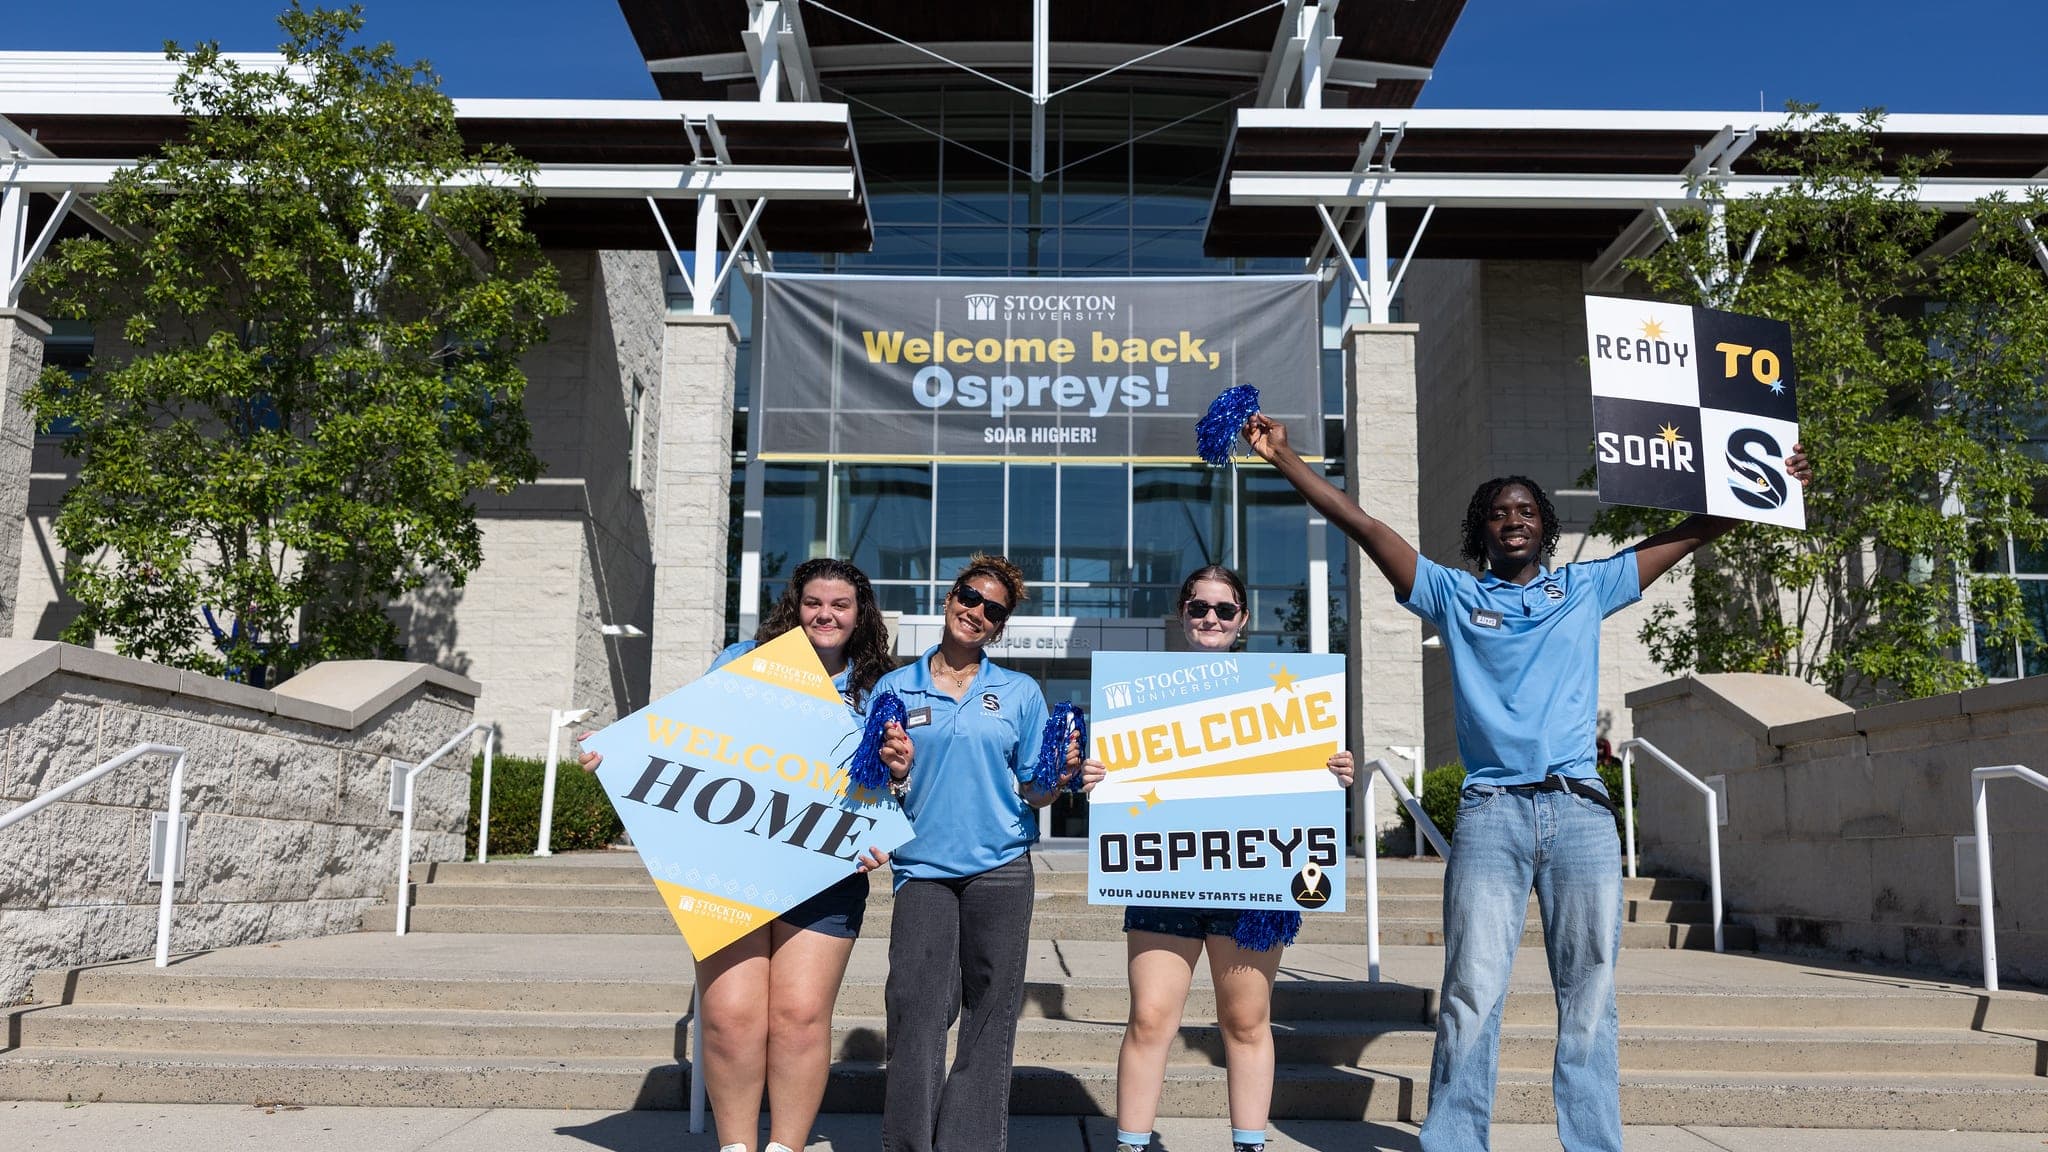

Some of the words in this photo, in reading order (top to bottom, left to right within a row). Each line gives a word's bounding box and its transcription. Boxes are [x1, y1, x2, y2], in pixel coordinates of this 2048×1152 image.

[1003, 295, 1117, 311] STOCKTON
[1003, 311, 1117, 321] UNIVERSITY
[862, 330, 1077, 363] Welcome
[1091, 331, 1221, 370] back,
[1596, 334, 1689, 368] READY
[1715, 342, 1780, 385] TO
[912, 365, 1170, 417] Ospreys!
[984, 427, 1026, 444] SOAR
[1031, 427, 1098, 444] HIGHER!
[1598, 432, 1696, 473] SOAR
[986, 637, 1031, 649] MPUS
[1036, 637, 1090, 649] CENTER
[768, 662, 823, 683] STOCKTON
[1135, 658, 1239, 693] STOCKTON
[1137, 674, 1240, 704] UNIVERSITY
[1096, 691, 1338, 772] WELCOME
[621, 754, 878, 862] HOME
[1100, 827, 1337, 873] OSPREYS
[696, 899, 752, 922] STOCKTON
[1099, 888, 1133, 898] YOUR
[1136, 889, 1195, 900] JOURNEY
[1199, 891, 1246, 901] STARTS
[1250, 892, 1283, 902] HERE
